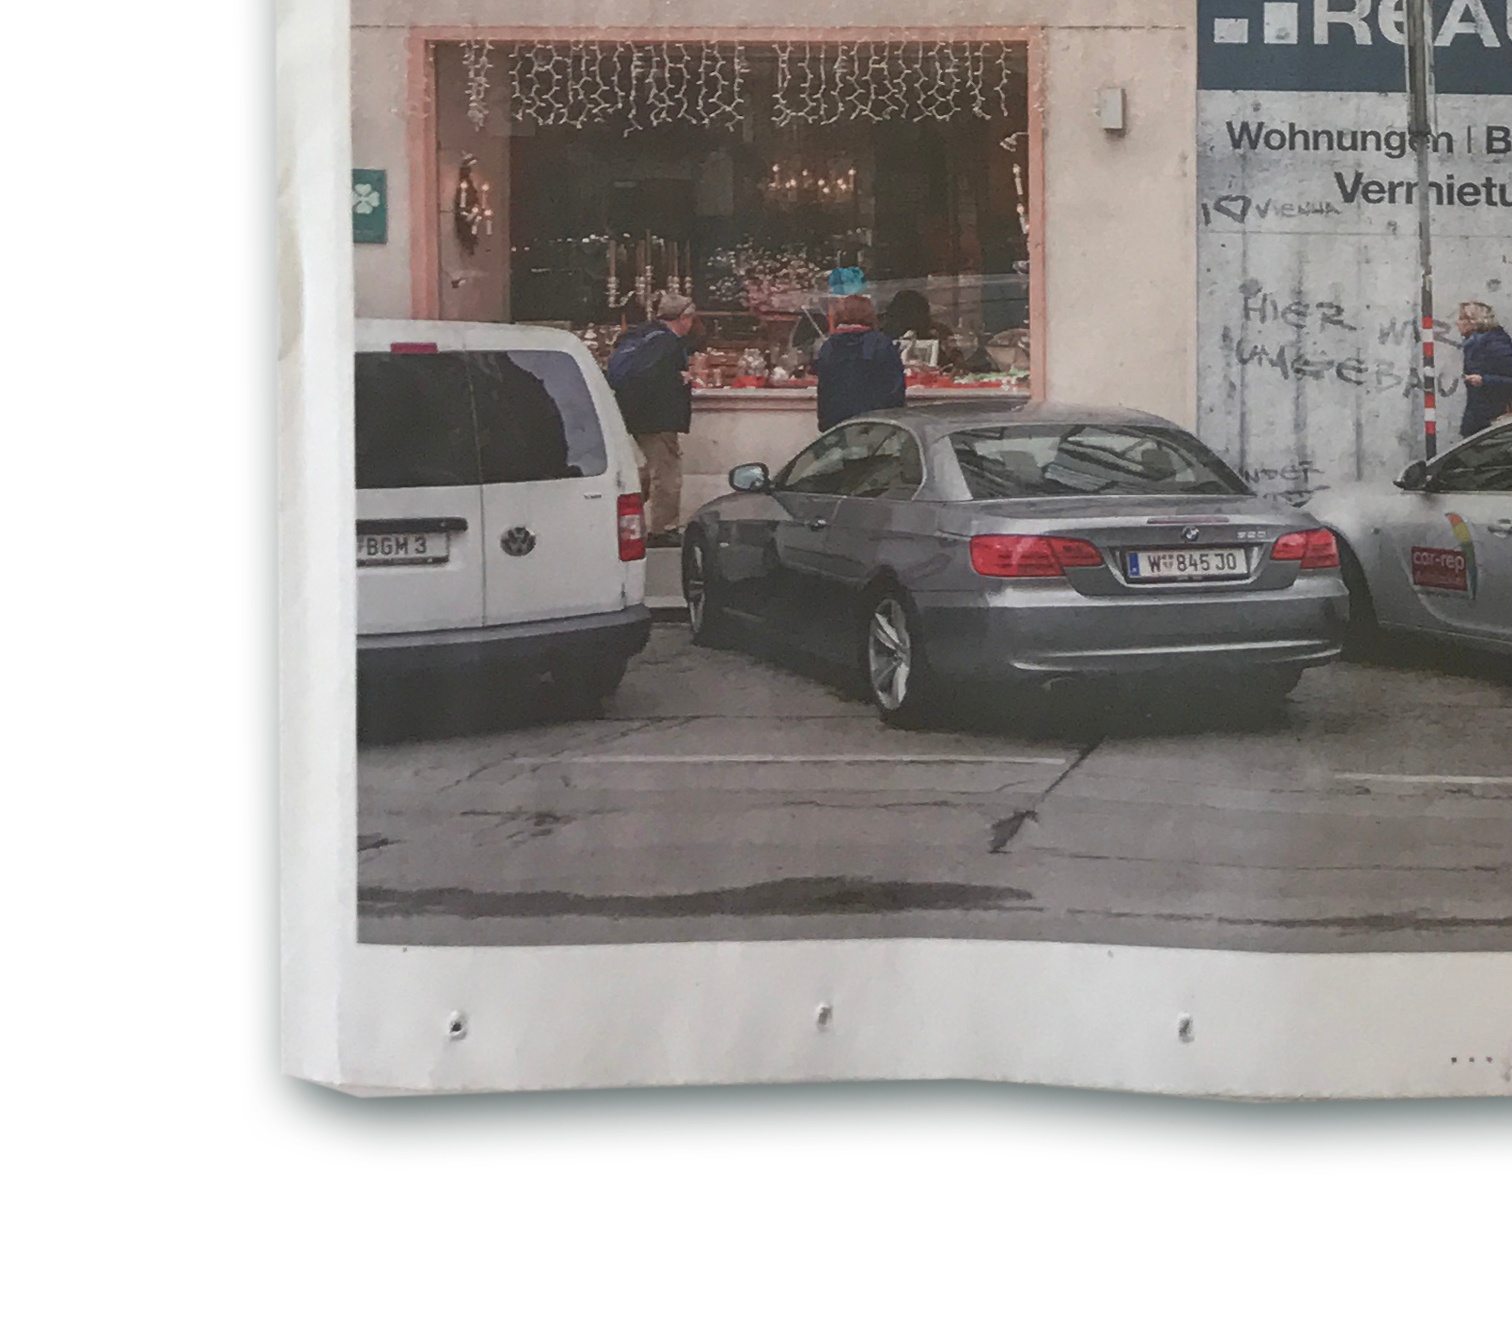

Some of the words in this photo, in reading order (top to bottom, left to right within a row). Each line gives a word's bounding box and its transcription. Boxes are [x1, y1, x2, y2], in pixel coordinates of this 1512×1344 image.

[366, 536, 408, 556] BGM
[415, 536, 427, 554] 3
[1147, 554, 1161, 573] W
[1177, 553, 1210, 572] 845
[1413, 551, 1465, 573] car-rep
